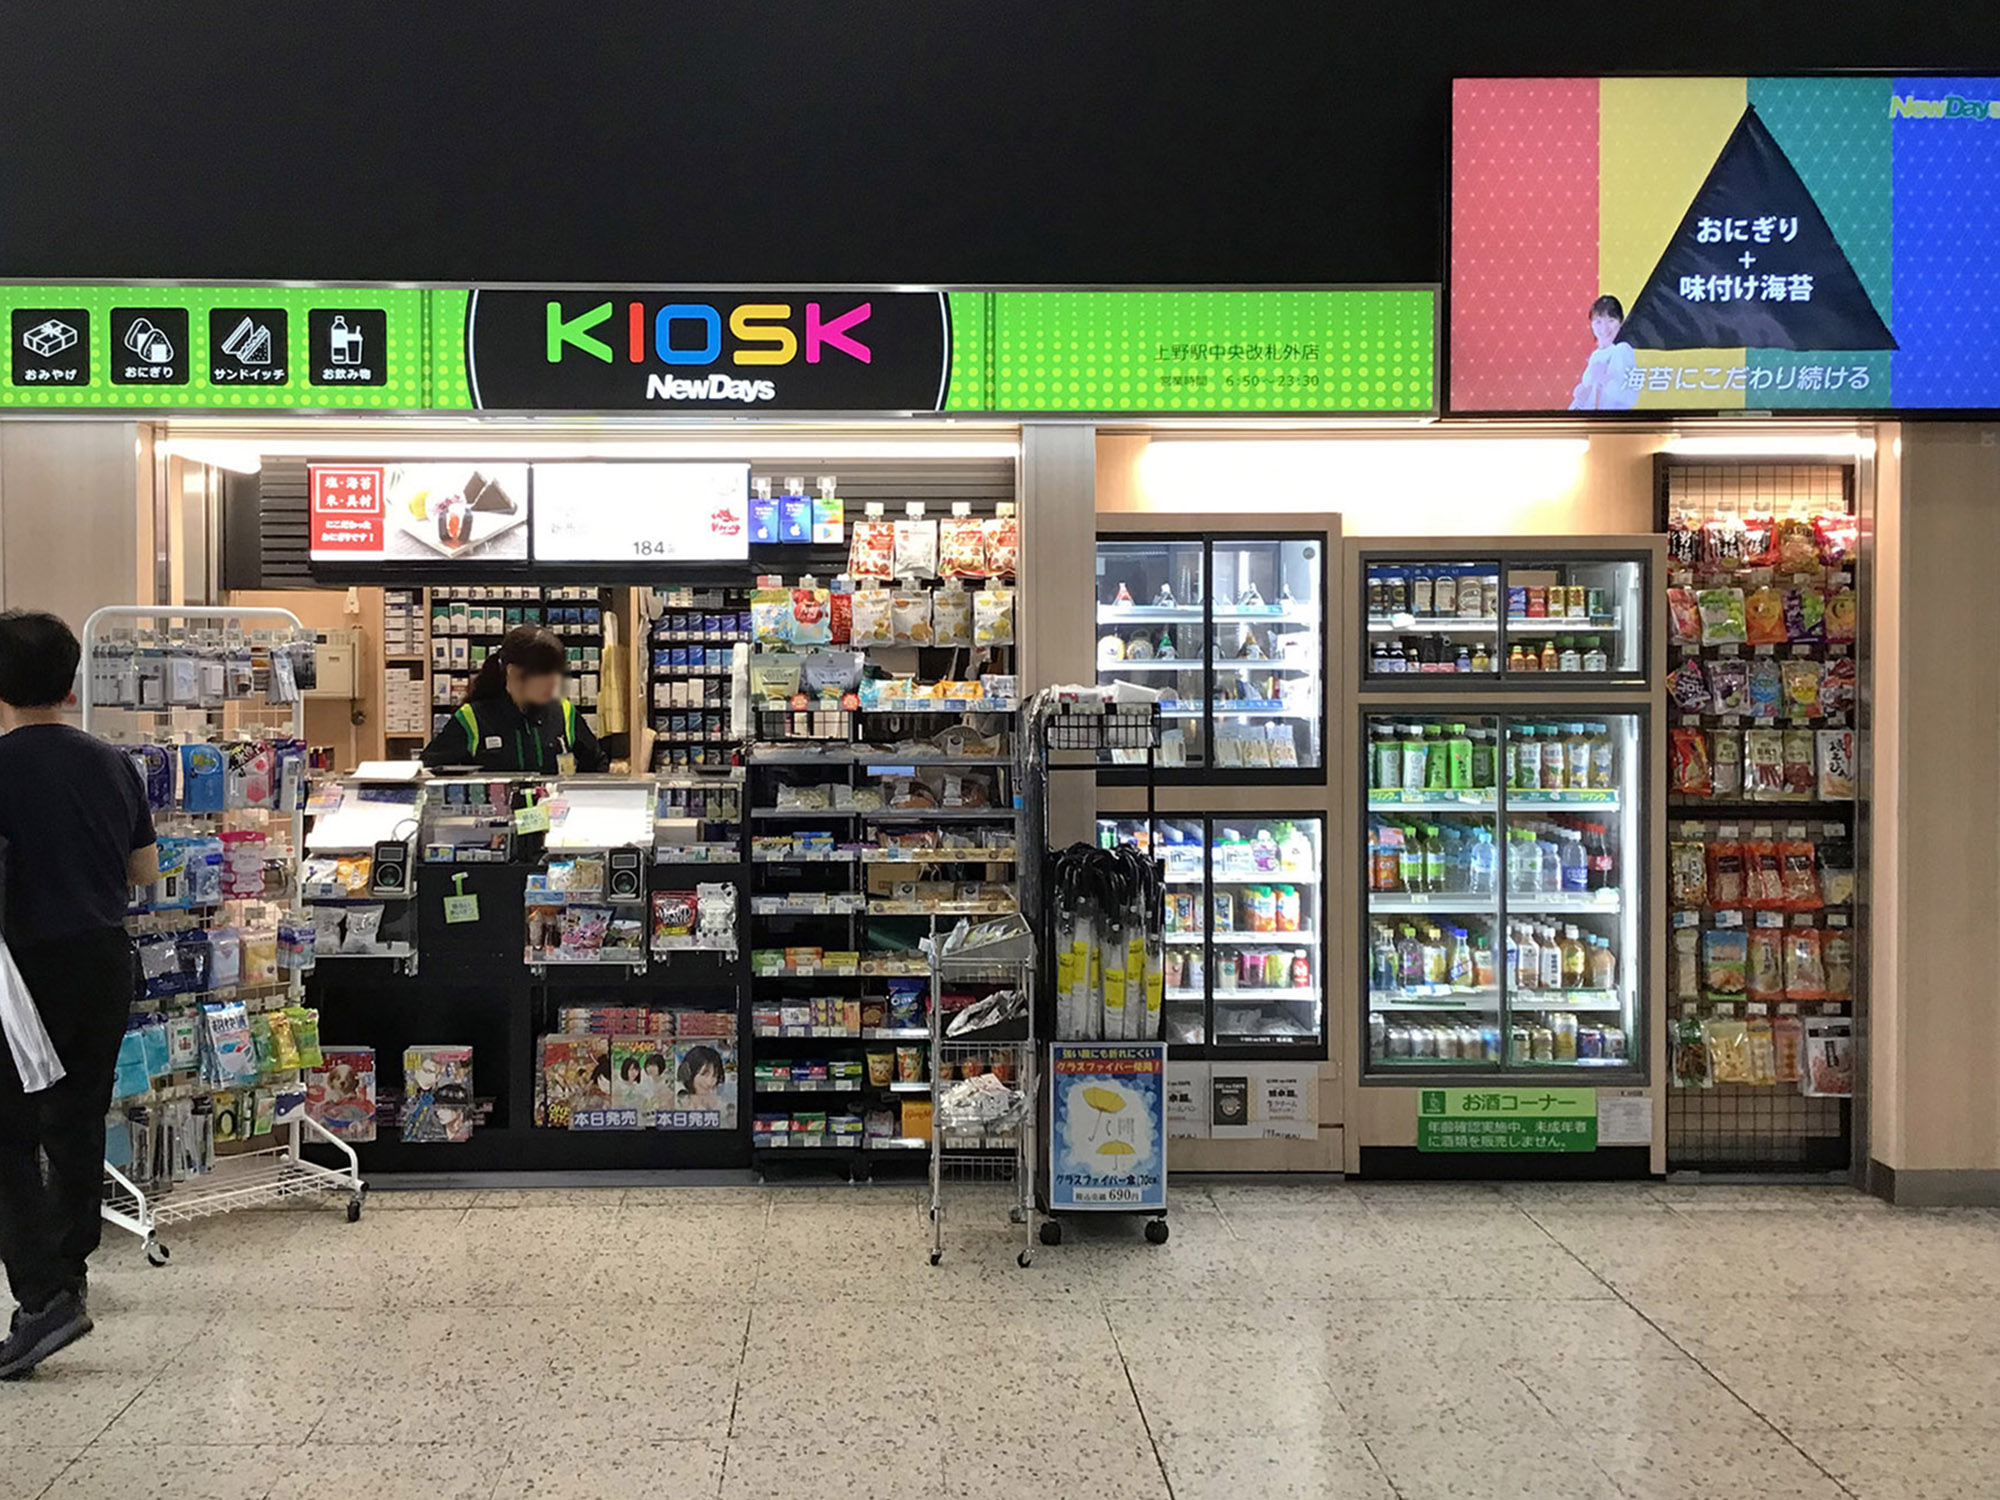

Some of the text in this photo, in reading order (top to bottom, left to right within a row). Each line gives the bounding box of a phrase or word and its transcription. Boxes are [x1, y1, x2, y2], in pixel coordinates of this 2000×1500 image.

[1697, 217, 1799, 243] おにぎり
[1680, 276, 1814, 303] 味付け海苔
[547, 301, 871, 366] KIOSK
[1154, 344, 1319, 362] 上野駅中央改札外店
[24, 367, 77, 382] おみやげ
[124, 365, 174, 380] おにぎり
[213, 367, 285, 382] サンドイッチ
[322, 367, 371, 382] お飲み物
[1621, 366, 1871, 392] 海苔にこだわり続ける
[646, 373, 775, 402] NewDays
[633, 540, 665, 556] 184
[1462, 1093, 1577, 1111] お酒コーナー
[573, 1110, 637, 1126] 本日発売
[656, 1111, 721, 1127] 本日発売
